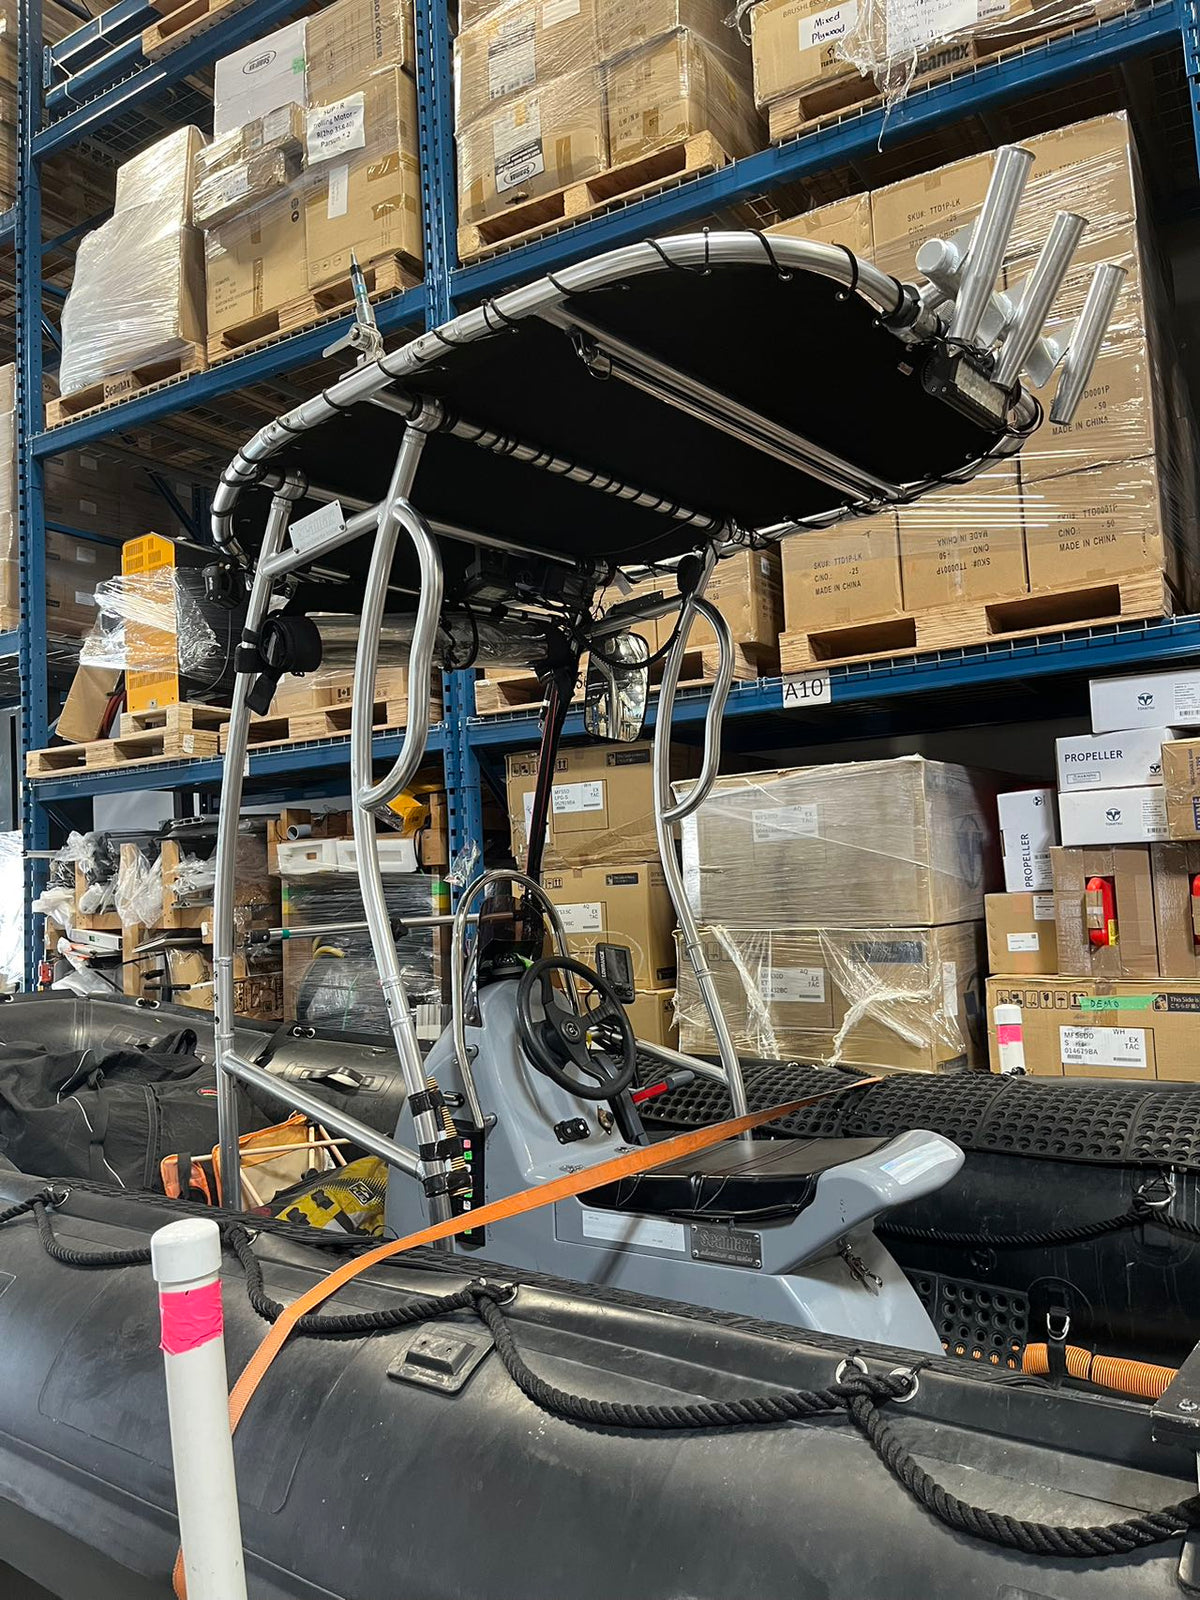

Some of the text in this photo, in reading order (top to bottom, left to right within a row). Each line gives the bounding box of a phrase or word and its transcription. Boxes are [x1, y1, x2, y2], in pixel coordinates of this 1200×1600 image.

[814, 11, 841, 29] Mixed
[375, 26, 383, 59] COVER
[811, 24, 846, 44] Plywood
[334, 112, 353, 122] Motor
[1052, 415, 1109, 436] MADE IN CHINA
[936, 529, 989, 547] MADE IN CHINA
[1059, 533, 1117, 552] MADE IN CHINA
[815, 580, 862, 595] MADE IN CHINA
[784, 678, 823, 700] A10
[1064, 749, 1123, 763] PROPELLER
[1020, 833, 1035, 888] PROPELLER
[1090, 999, 1120, 1009] DEMO
